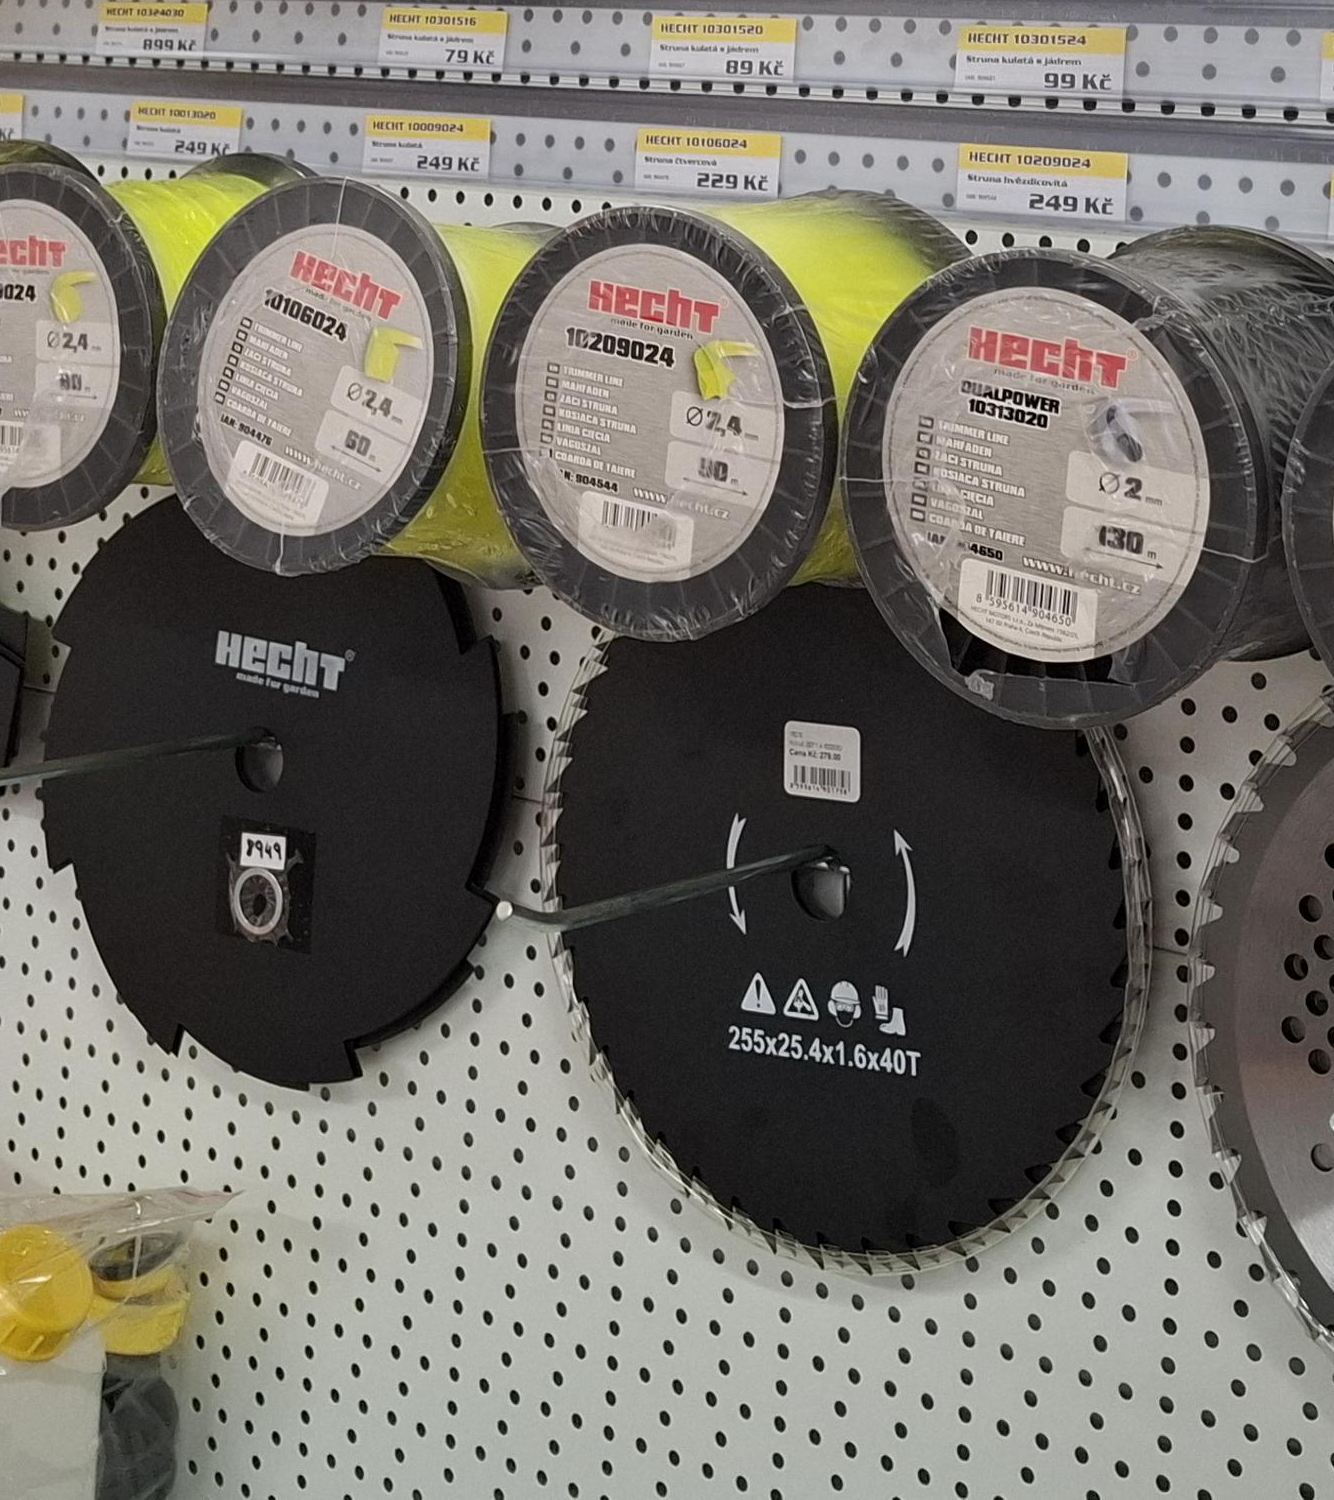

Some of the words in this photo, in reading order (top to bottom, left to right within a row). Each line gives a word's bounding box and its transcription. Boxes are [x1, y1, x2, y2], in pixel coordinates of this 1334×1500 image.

[661, 23, 699, 34] HECHT
[703, 24, 764, 35] 10301520
[968, 32, 1009, 44] HECHT
[1015, 34, 1087, 46] 10301524
[725, 60, 753, 75] 89
[759, 60, 784, 76] Kč
[1044, 73, 1076, 89] 99
[1082, 73, 1112, 91] Kč
[645, 135, 683, 146] HECHT
[686, 137, 747, 149] 10106024
[969, 151, 1011, 164] HECHT
[1017, 155, 1091, 169] 10209024
[697, 173, 738, 189] 229
[744, 175, 769, 191] Kč
[1029, 193, 1078, 212] 249
[1085, 197, 1114, 215] Kč
[264, 288, 348, 343] 10106024
[565, 326, 676, 369] 10209024
[960, 380, 1061, 415] DUALPOWER
[968, 399, 1049, 430] 10313020
[236, 671, 262, 686] made
[282, 681, 320, 699] garden
[728, 1025, 921, 1077] 255x25.4x1.6x40T
